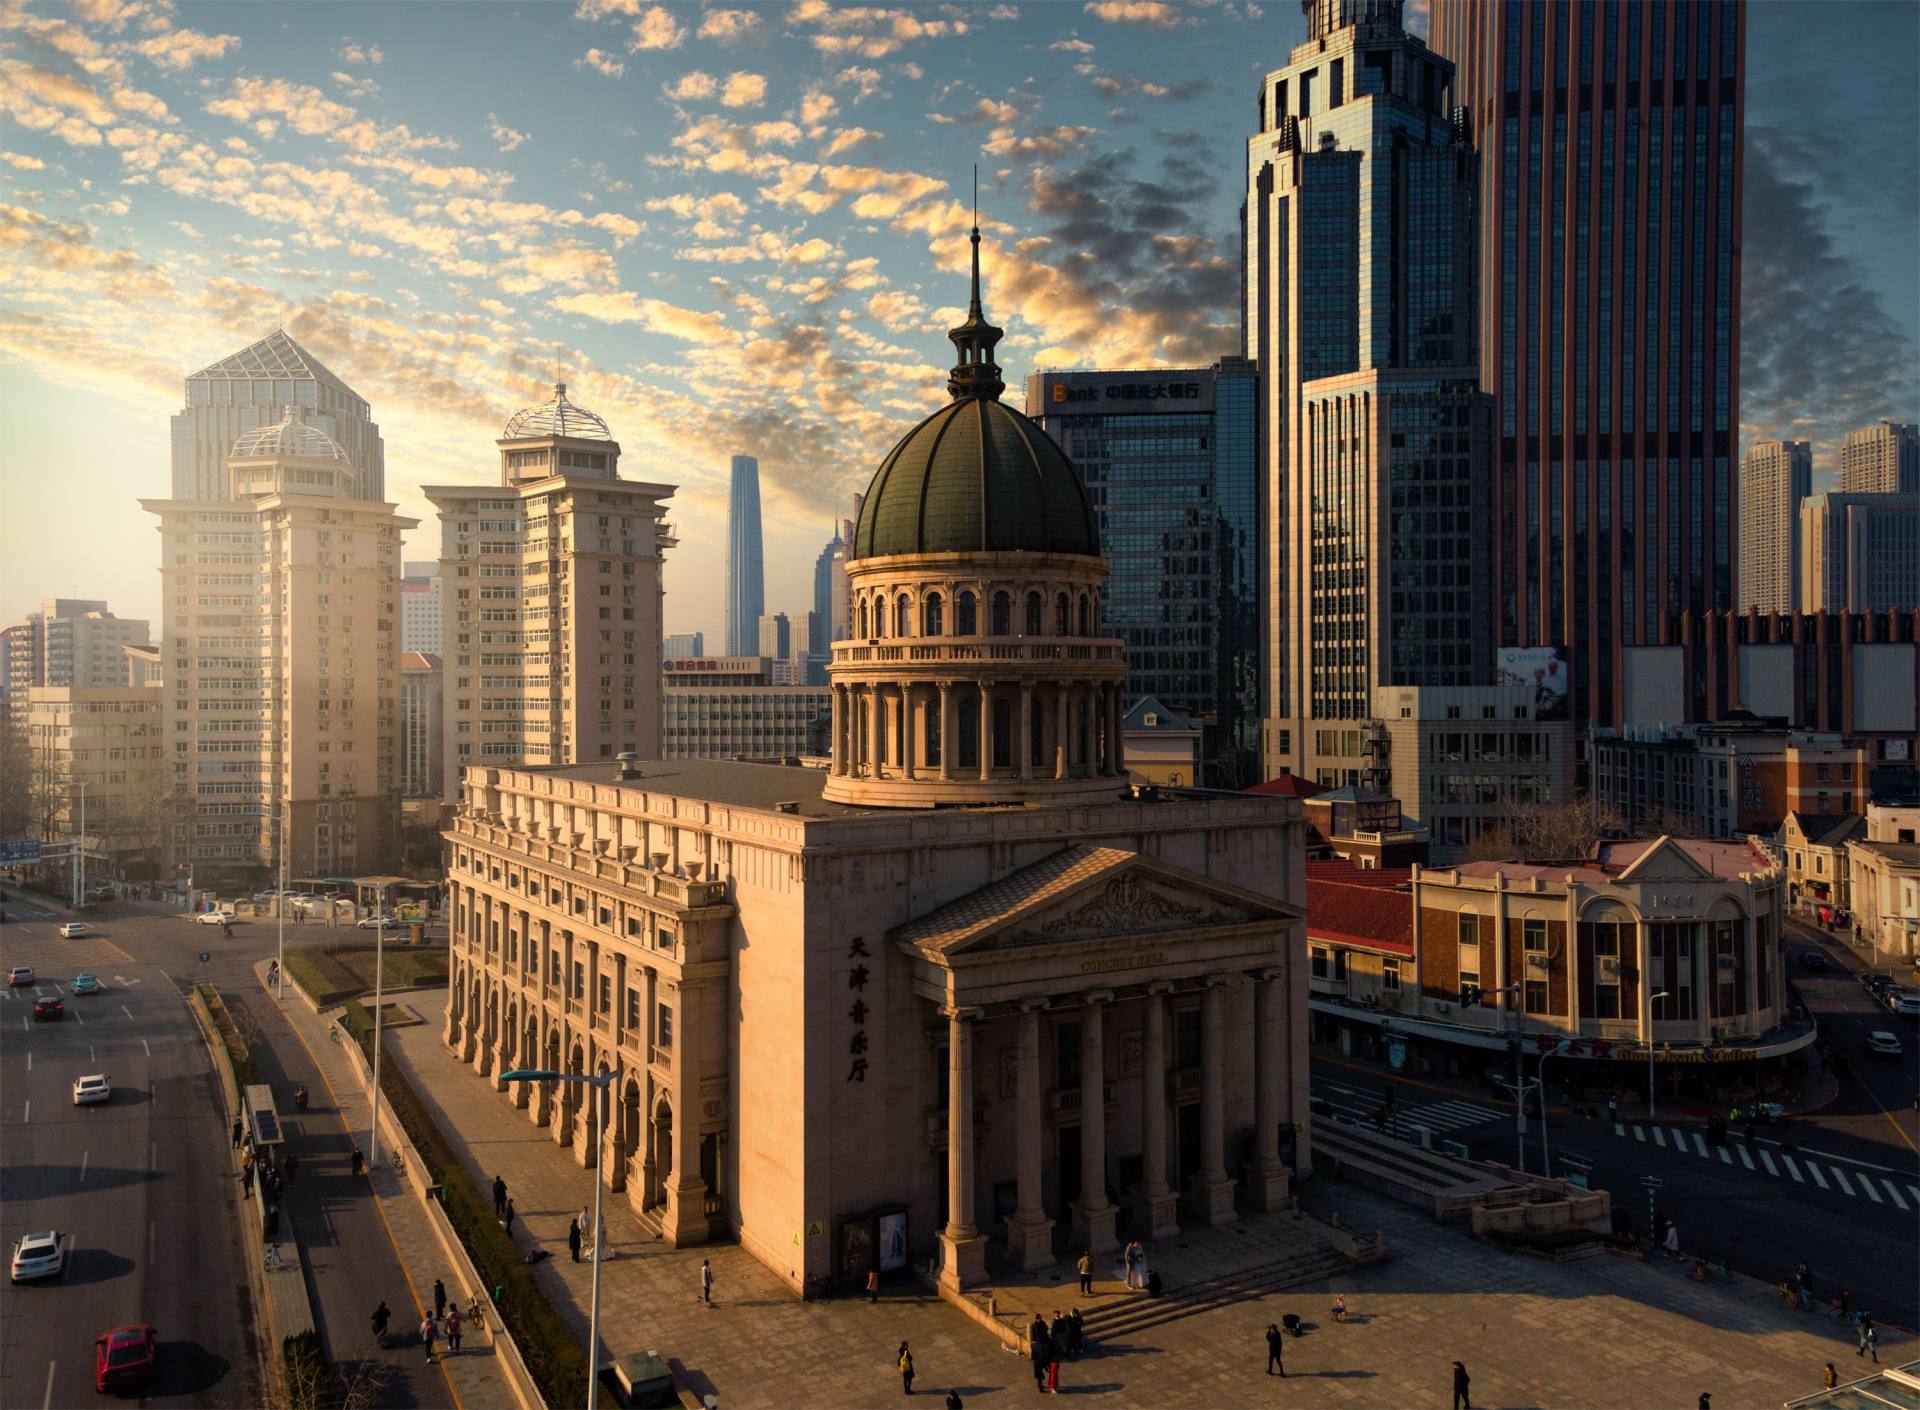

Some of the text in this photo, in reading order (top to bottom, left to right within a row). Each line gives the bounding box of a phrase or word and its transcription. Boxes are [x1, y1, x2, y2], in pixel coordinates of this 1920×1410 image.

[1053, 383, 1100, 403] Bank
[1106, 382, 1199, 401] 中国光大银行
[847, 936, 871, 1082] 天津音乐厅
